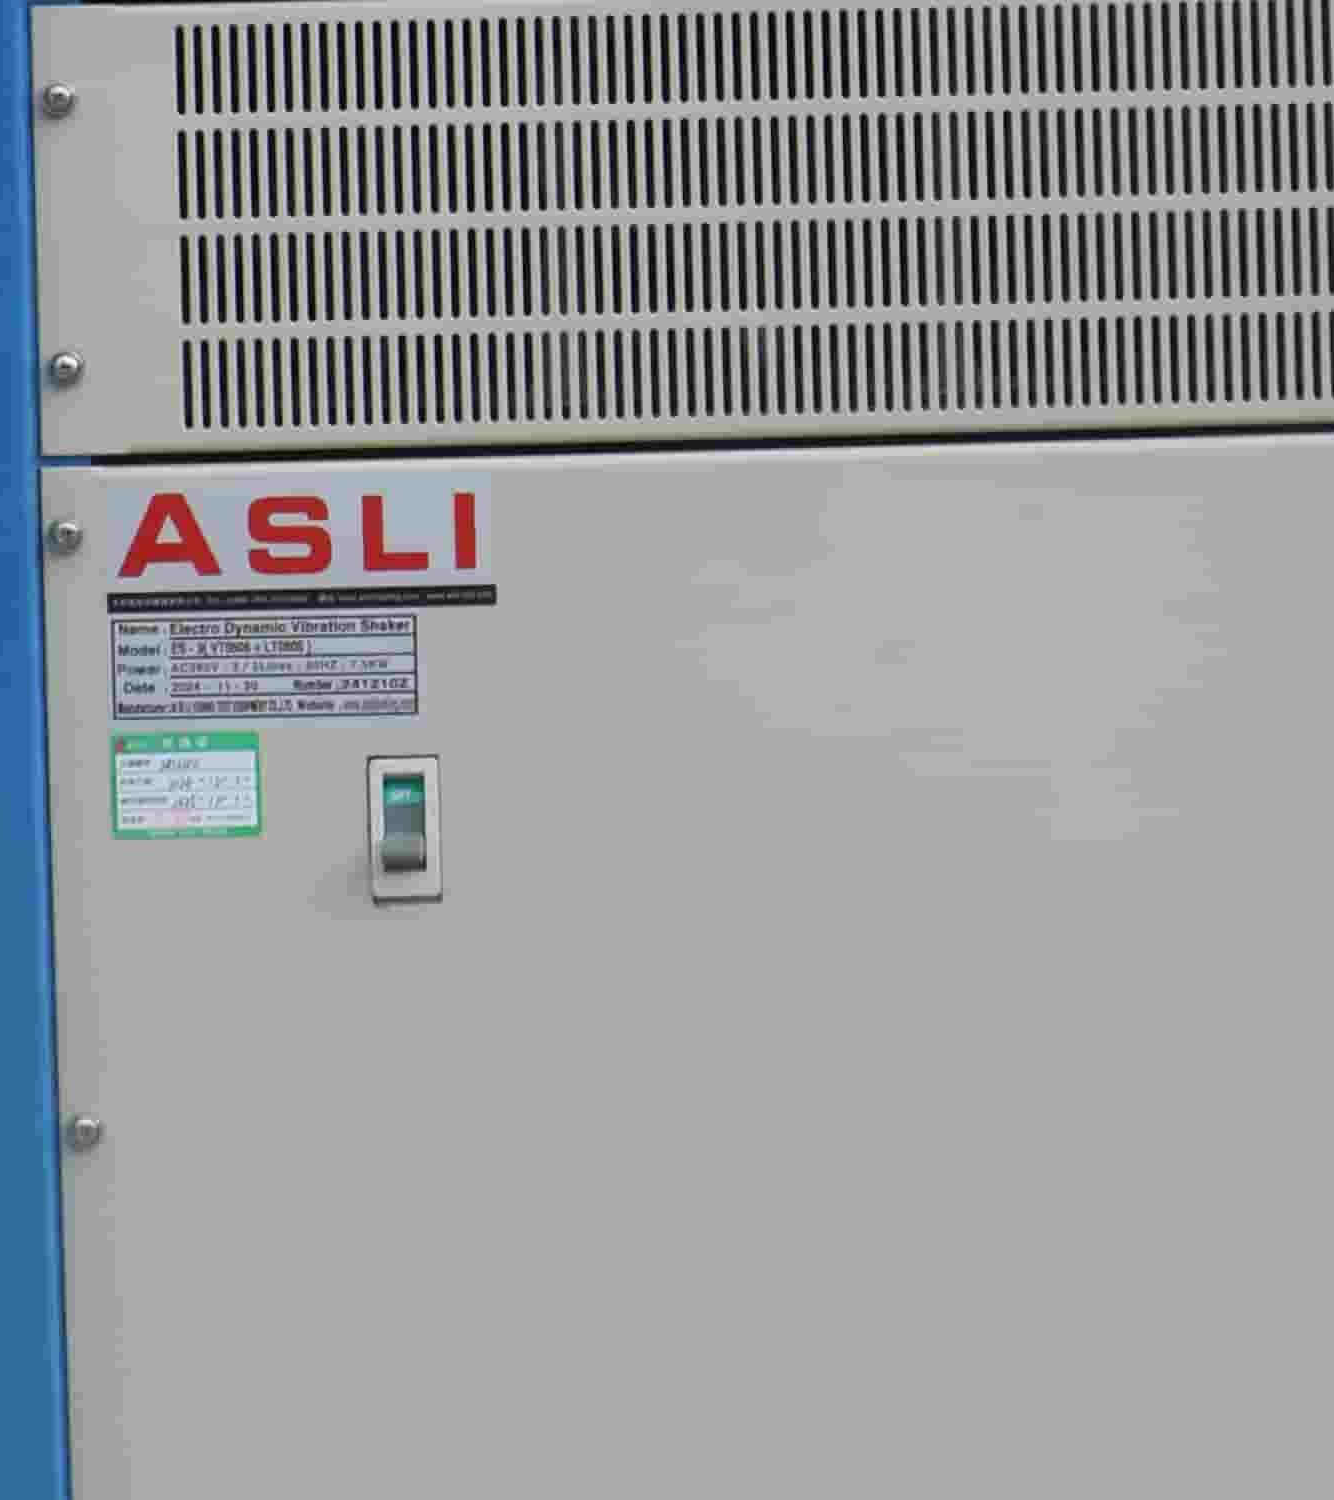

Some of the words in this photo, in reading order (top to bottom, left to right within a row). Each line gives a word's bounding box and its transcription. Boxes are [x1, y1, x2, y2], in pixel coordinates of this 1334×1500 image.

[118, 493, 476, 578] ASLI
[170, 622, 220, 635] Electro
[224, 619, 287, 637] Dynamic
[290, 618, 356, 633] Vibration
[360, 618, 411, 632] Shaker
